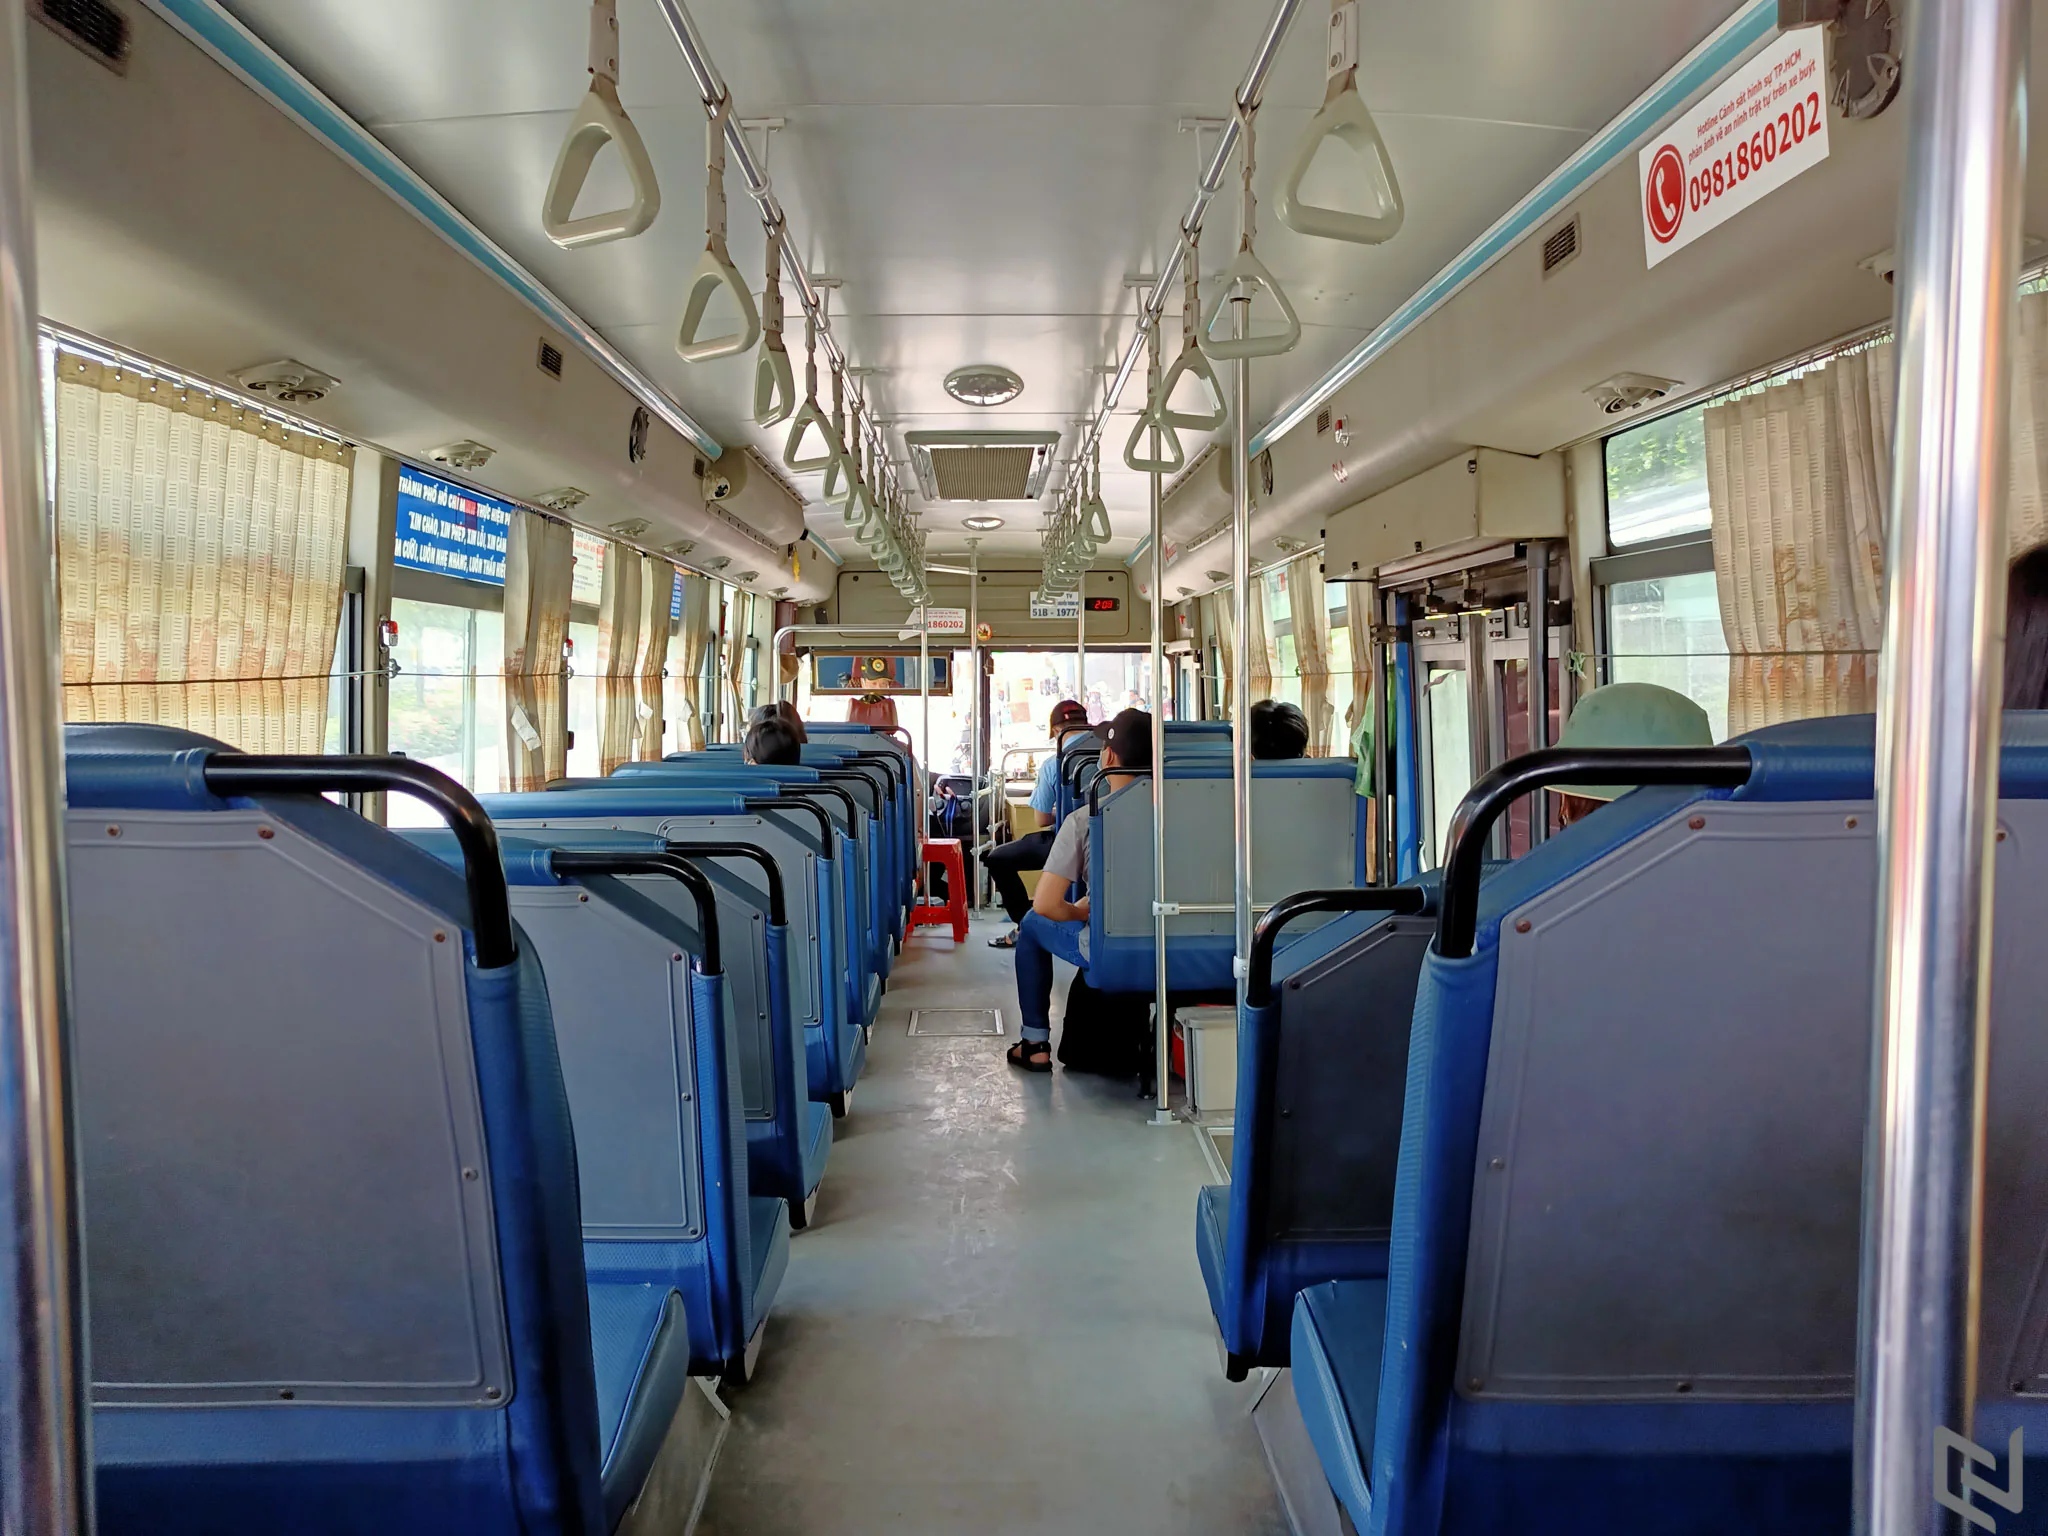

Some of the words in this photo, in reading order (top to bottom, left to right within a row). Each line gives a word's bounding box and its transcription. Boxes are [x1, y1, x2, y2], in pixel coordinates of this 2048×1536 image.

[1696, 114, 1718, 138] Hotline
[1773, 48, 1802, 79] TP.HCM
[1724, 122, 1732, 137] an
[1733, 109, 1748, 131] ninh
[1788, 73, 1798, 90] xe
[1798, 58, 1816, 83] buýt
[1689, 91, 1821, 213] 0981860202
[398, 474, 423, 499] THÀNH
[1032, 608, 1048, 617] 51B
